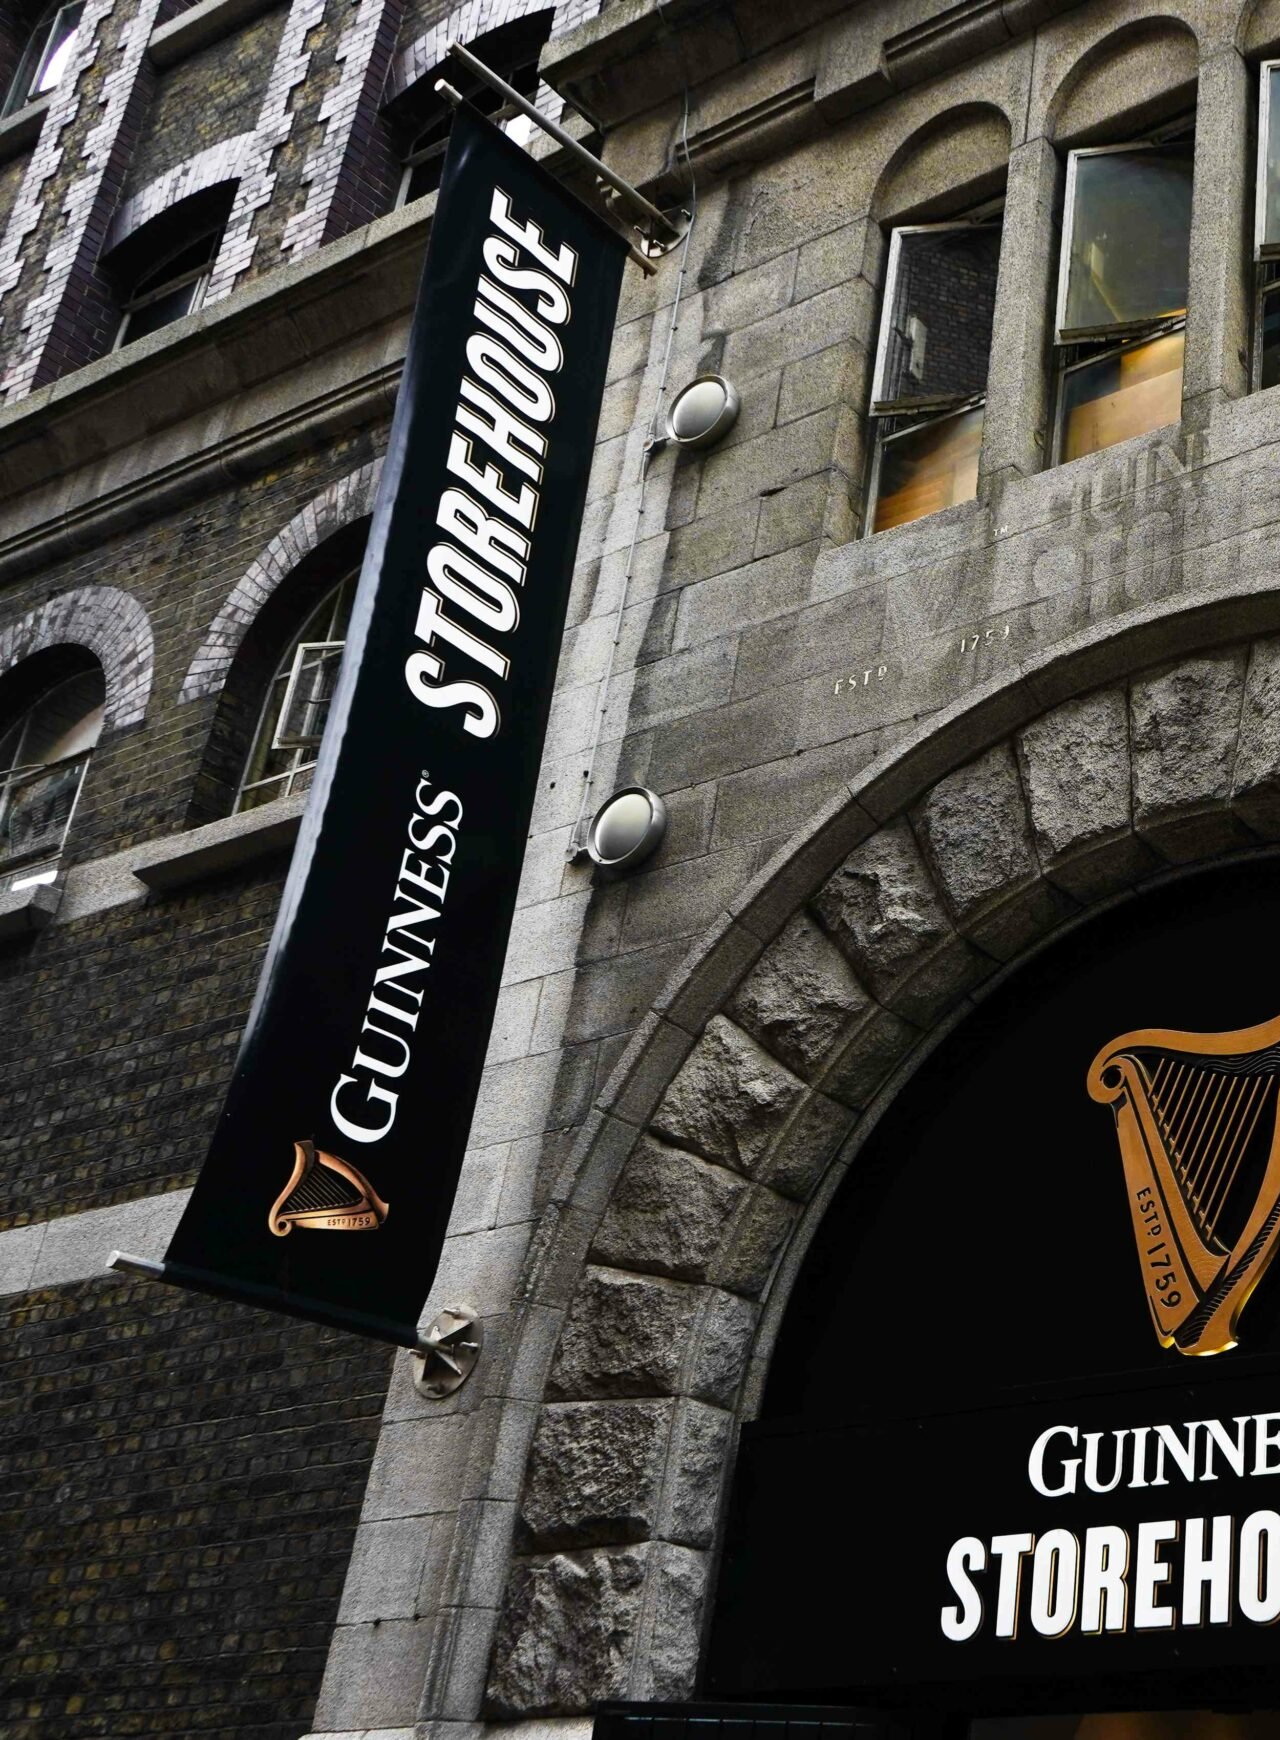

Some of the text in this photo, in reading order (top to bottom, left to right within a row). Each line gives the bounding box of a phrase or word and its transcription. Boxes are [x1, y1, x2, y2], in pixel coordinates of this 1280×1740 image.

[405, 186, 579, 740] STOREHOUSE
[348, 1216, 371, 1227] 1759
[1147, 1241, 1182, 1308] 1759
